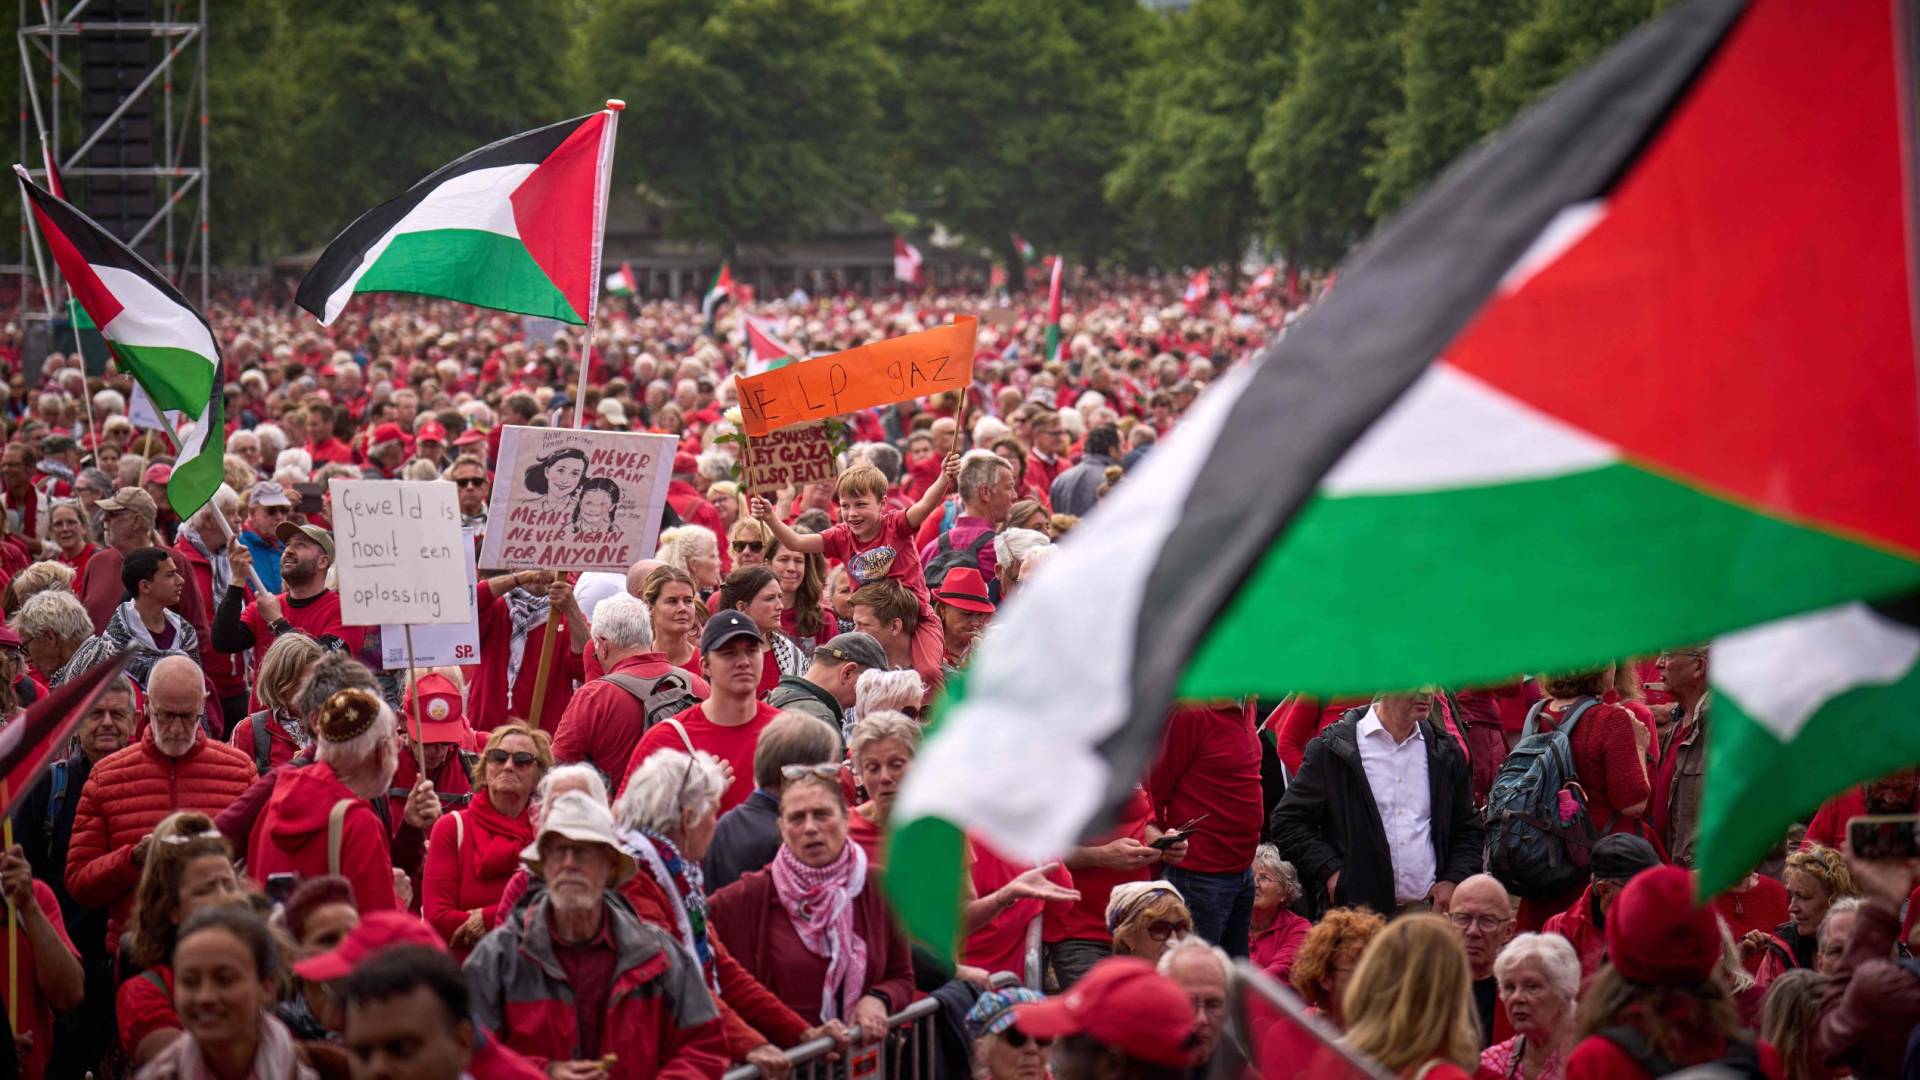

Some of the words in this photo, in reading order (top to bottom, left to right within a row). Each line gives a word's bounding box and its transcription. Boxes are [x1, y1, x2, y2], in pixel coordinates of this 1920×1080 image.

[590, 448, 650, 470] NEVER
[779, 443, 833, 462] GAZA
[792, 458, 834, 482] EAT!
[440, 502, 454, 520] is
[509, 506, 571, 526] MEANS
[351, 530, 399, 558] nooit
[420, 546, 451, 559] een
[507, 527, 566, 543] NEVER
[503, 545, 537, 559] FOR
[538, 545, 629, 565] ANYONE
[353, 584, 441, 617] oplossing
